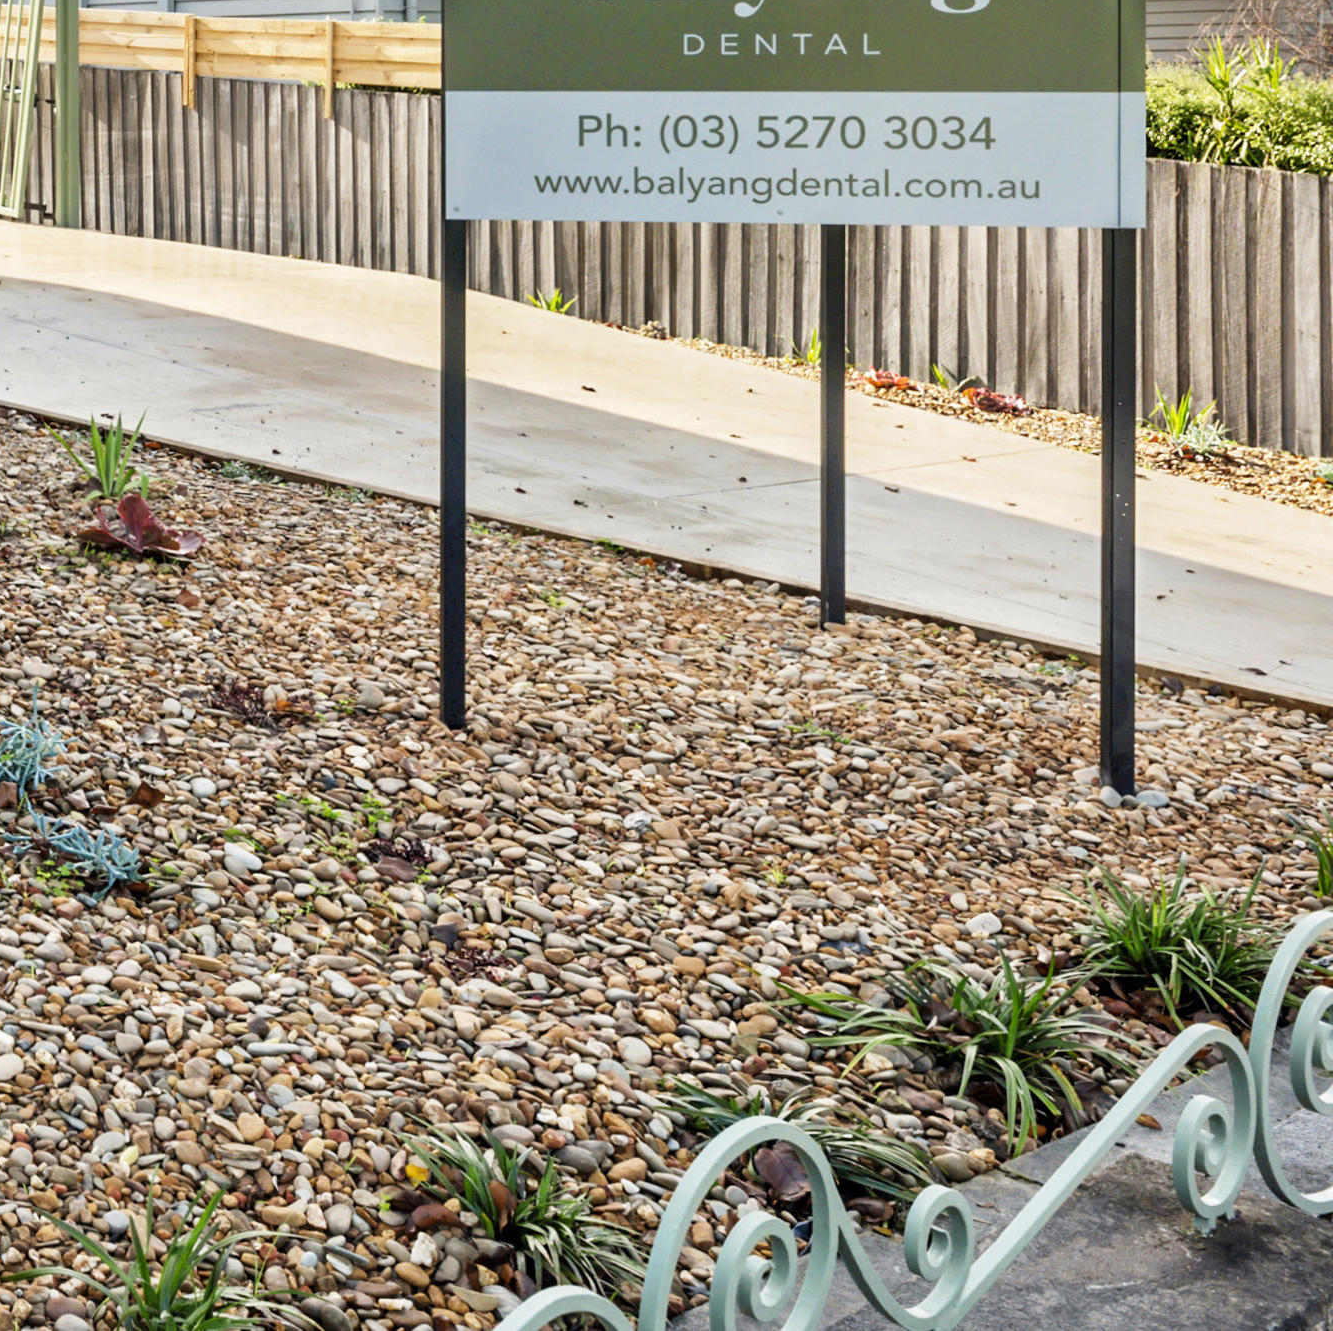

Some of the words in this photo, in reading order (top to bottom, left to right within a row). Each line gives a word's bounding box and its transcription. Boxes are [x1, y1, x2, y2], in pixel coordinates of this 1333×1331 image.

[683, 33, 882, 56] DENTAL
[578, 113, 642, 148] Ph:
[659, 114, 740, 155] (03)
[755, 115, 867, 150] 5270
[883, 115, 997, 151] 3034
[533, 166, 1041, 205] www.balyangdental.com.au
